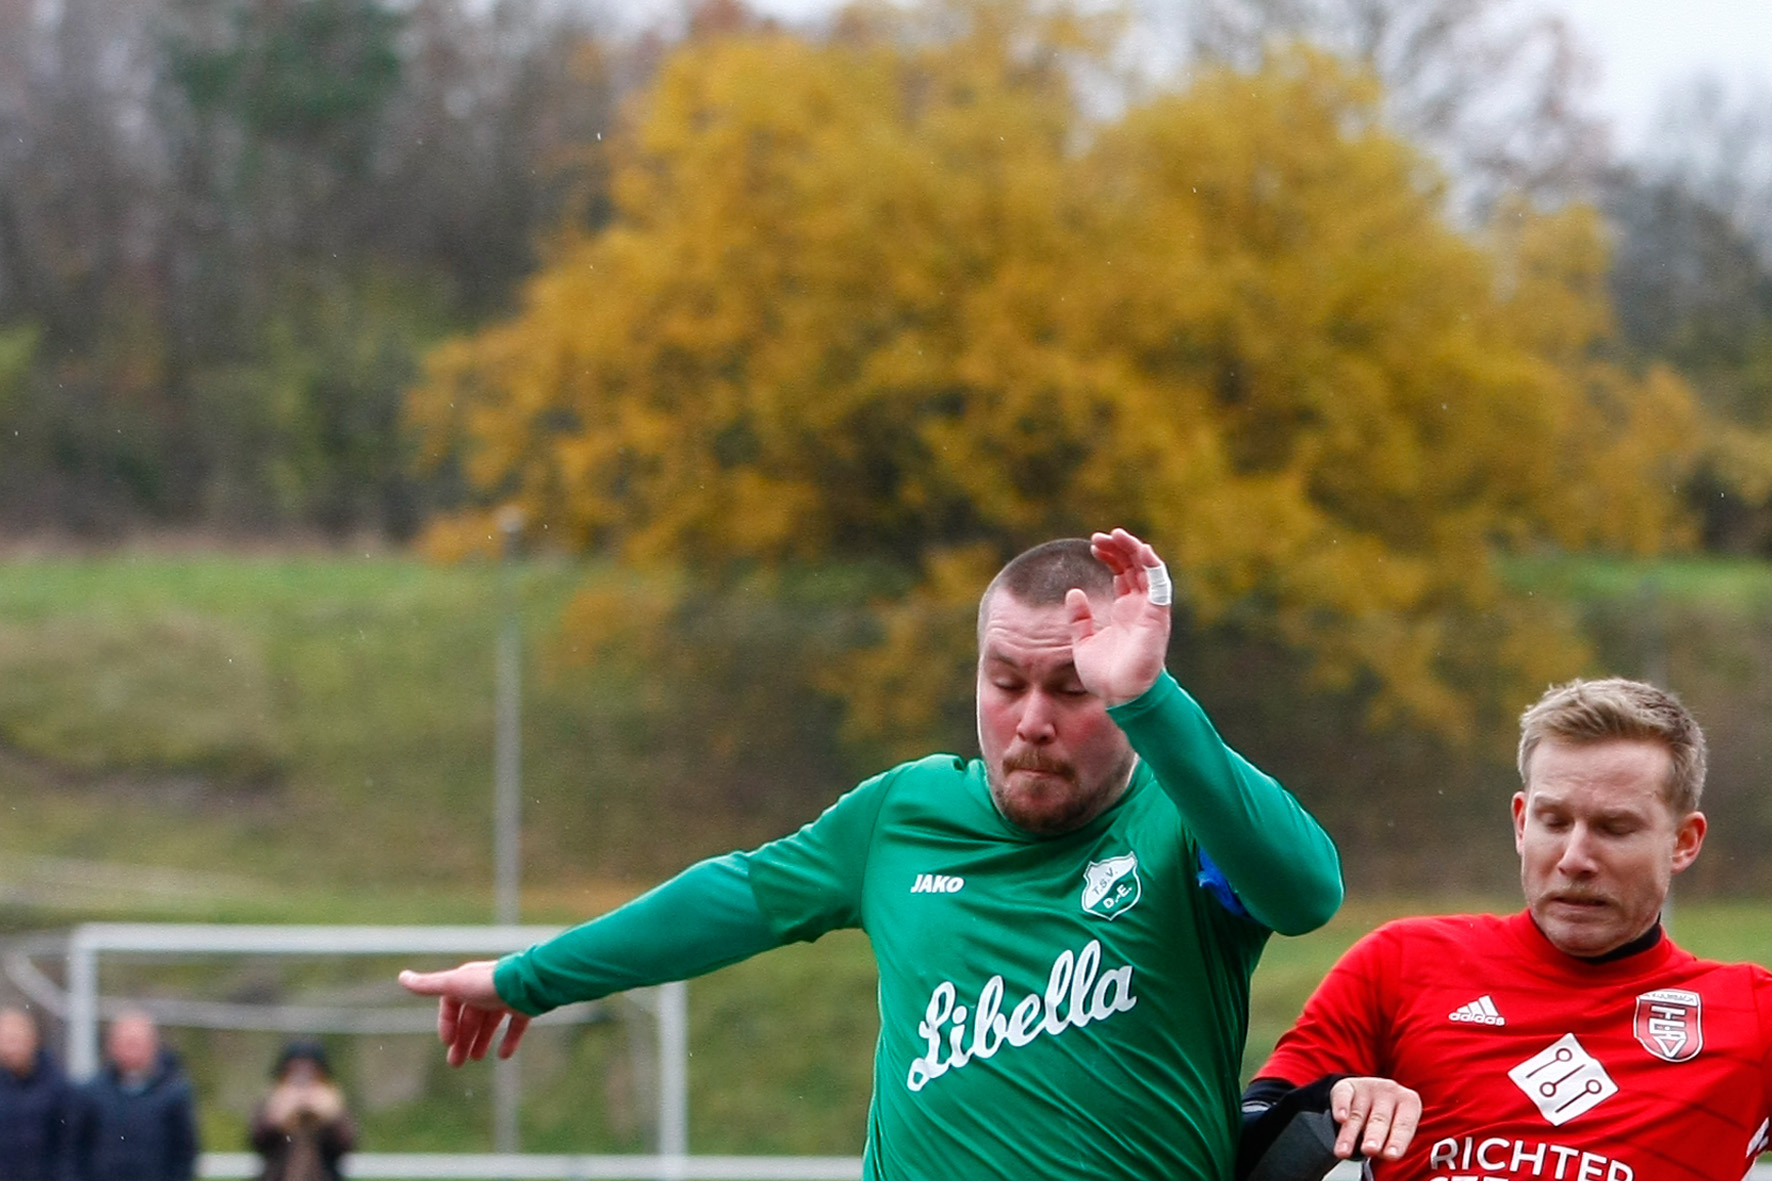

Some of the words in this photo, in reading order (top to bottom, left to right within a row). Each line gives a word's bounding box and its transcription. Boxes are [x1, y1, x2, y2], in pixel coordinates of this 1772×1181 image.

[910, 874, 965, 893] JAKO
[907, 939, 1137, 1092] Libella
[1448, 1012, 1505, 1027] adidas
